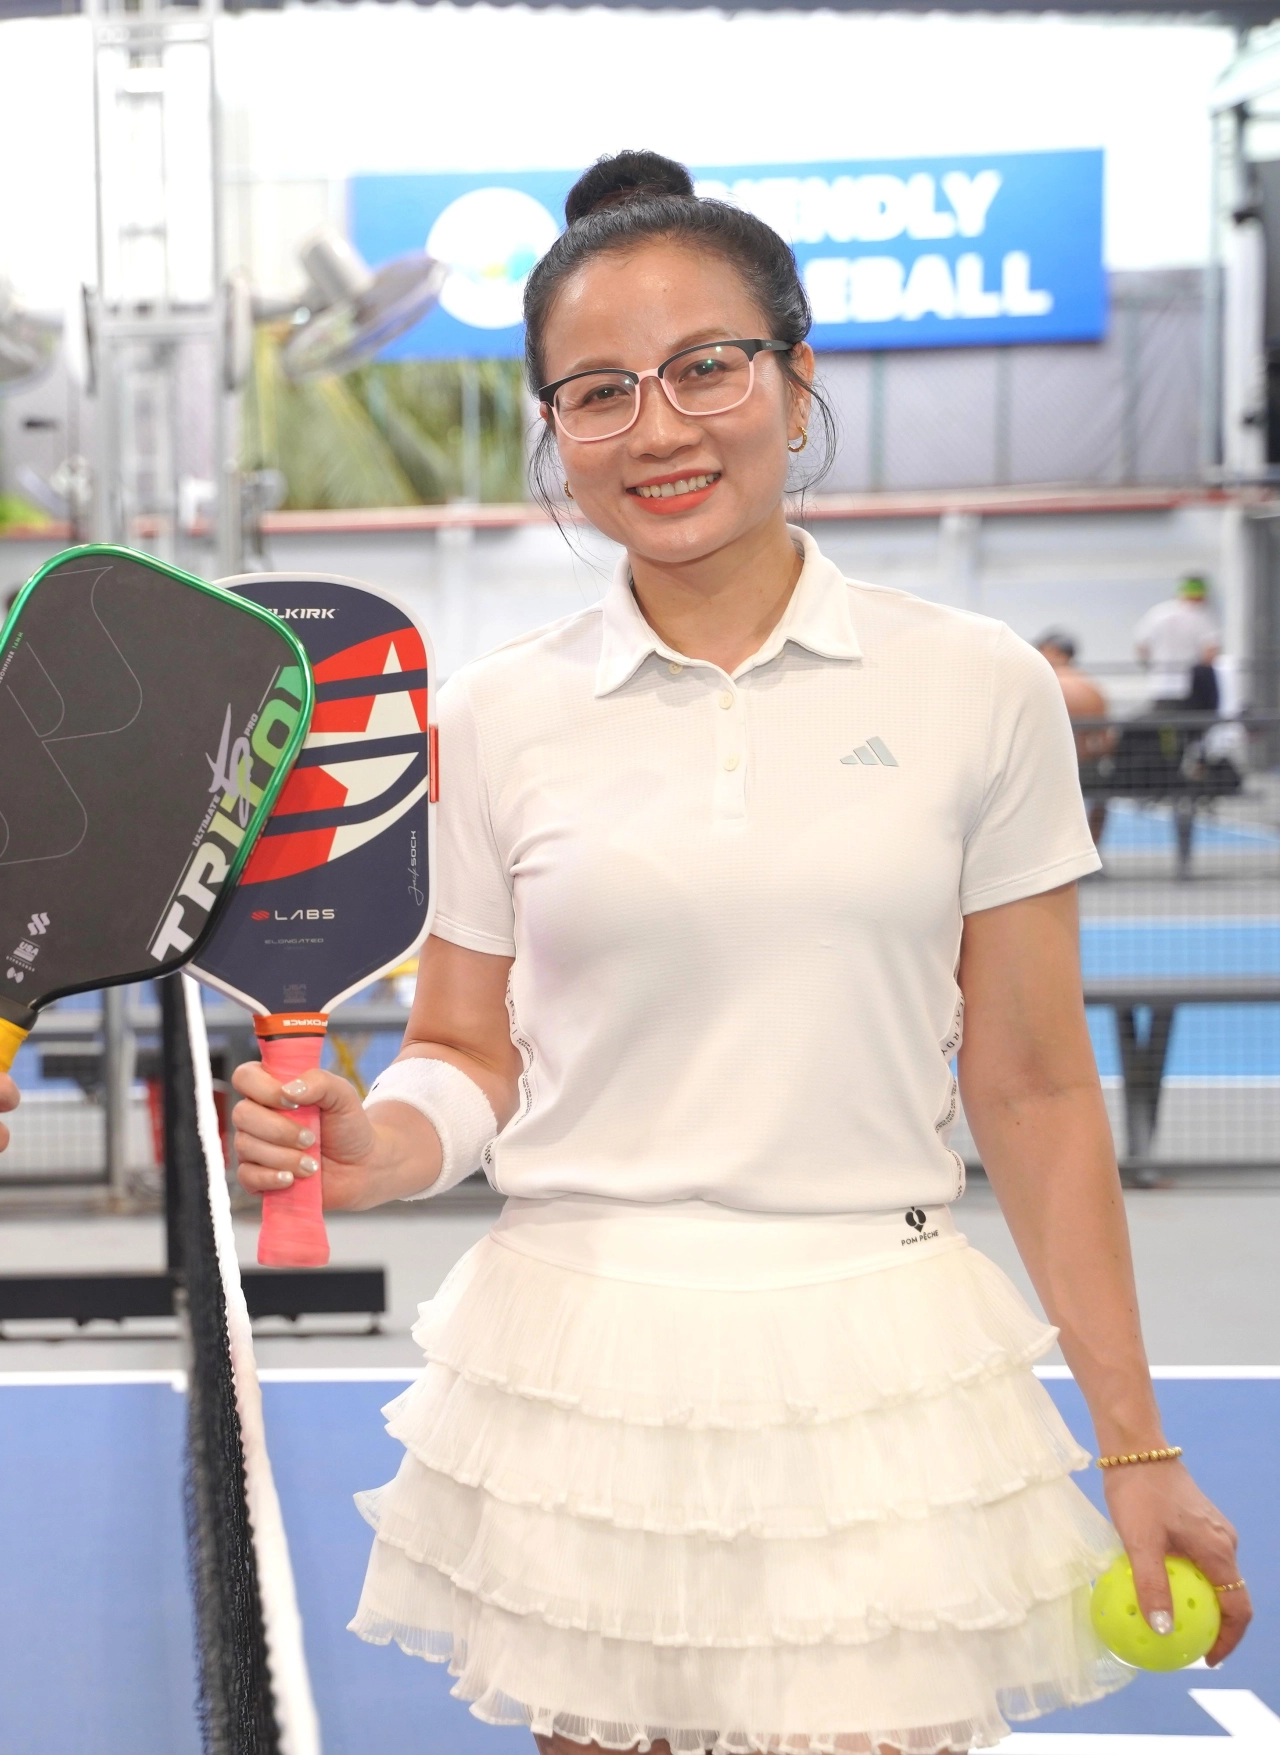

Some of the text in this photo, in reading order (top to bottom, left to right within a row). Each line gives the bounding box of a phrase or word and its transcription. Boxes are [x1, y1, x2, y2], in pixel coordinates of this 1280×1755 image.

[694, 168, 1003, 243] IENDLY
[802, 250, 1053, 323] EBALL
[269, 608, 336, 619] LKIRK
[192, 713, 259, 847] ULTIMATE PRO
[274, 909, 335, 920] LABS
[19, 941, 39, 956] USA
[901, 1237, 918, 1247] POM
